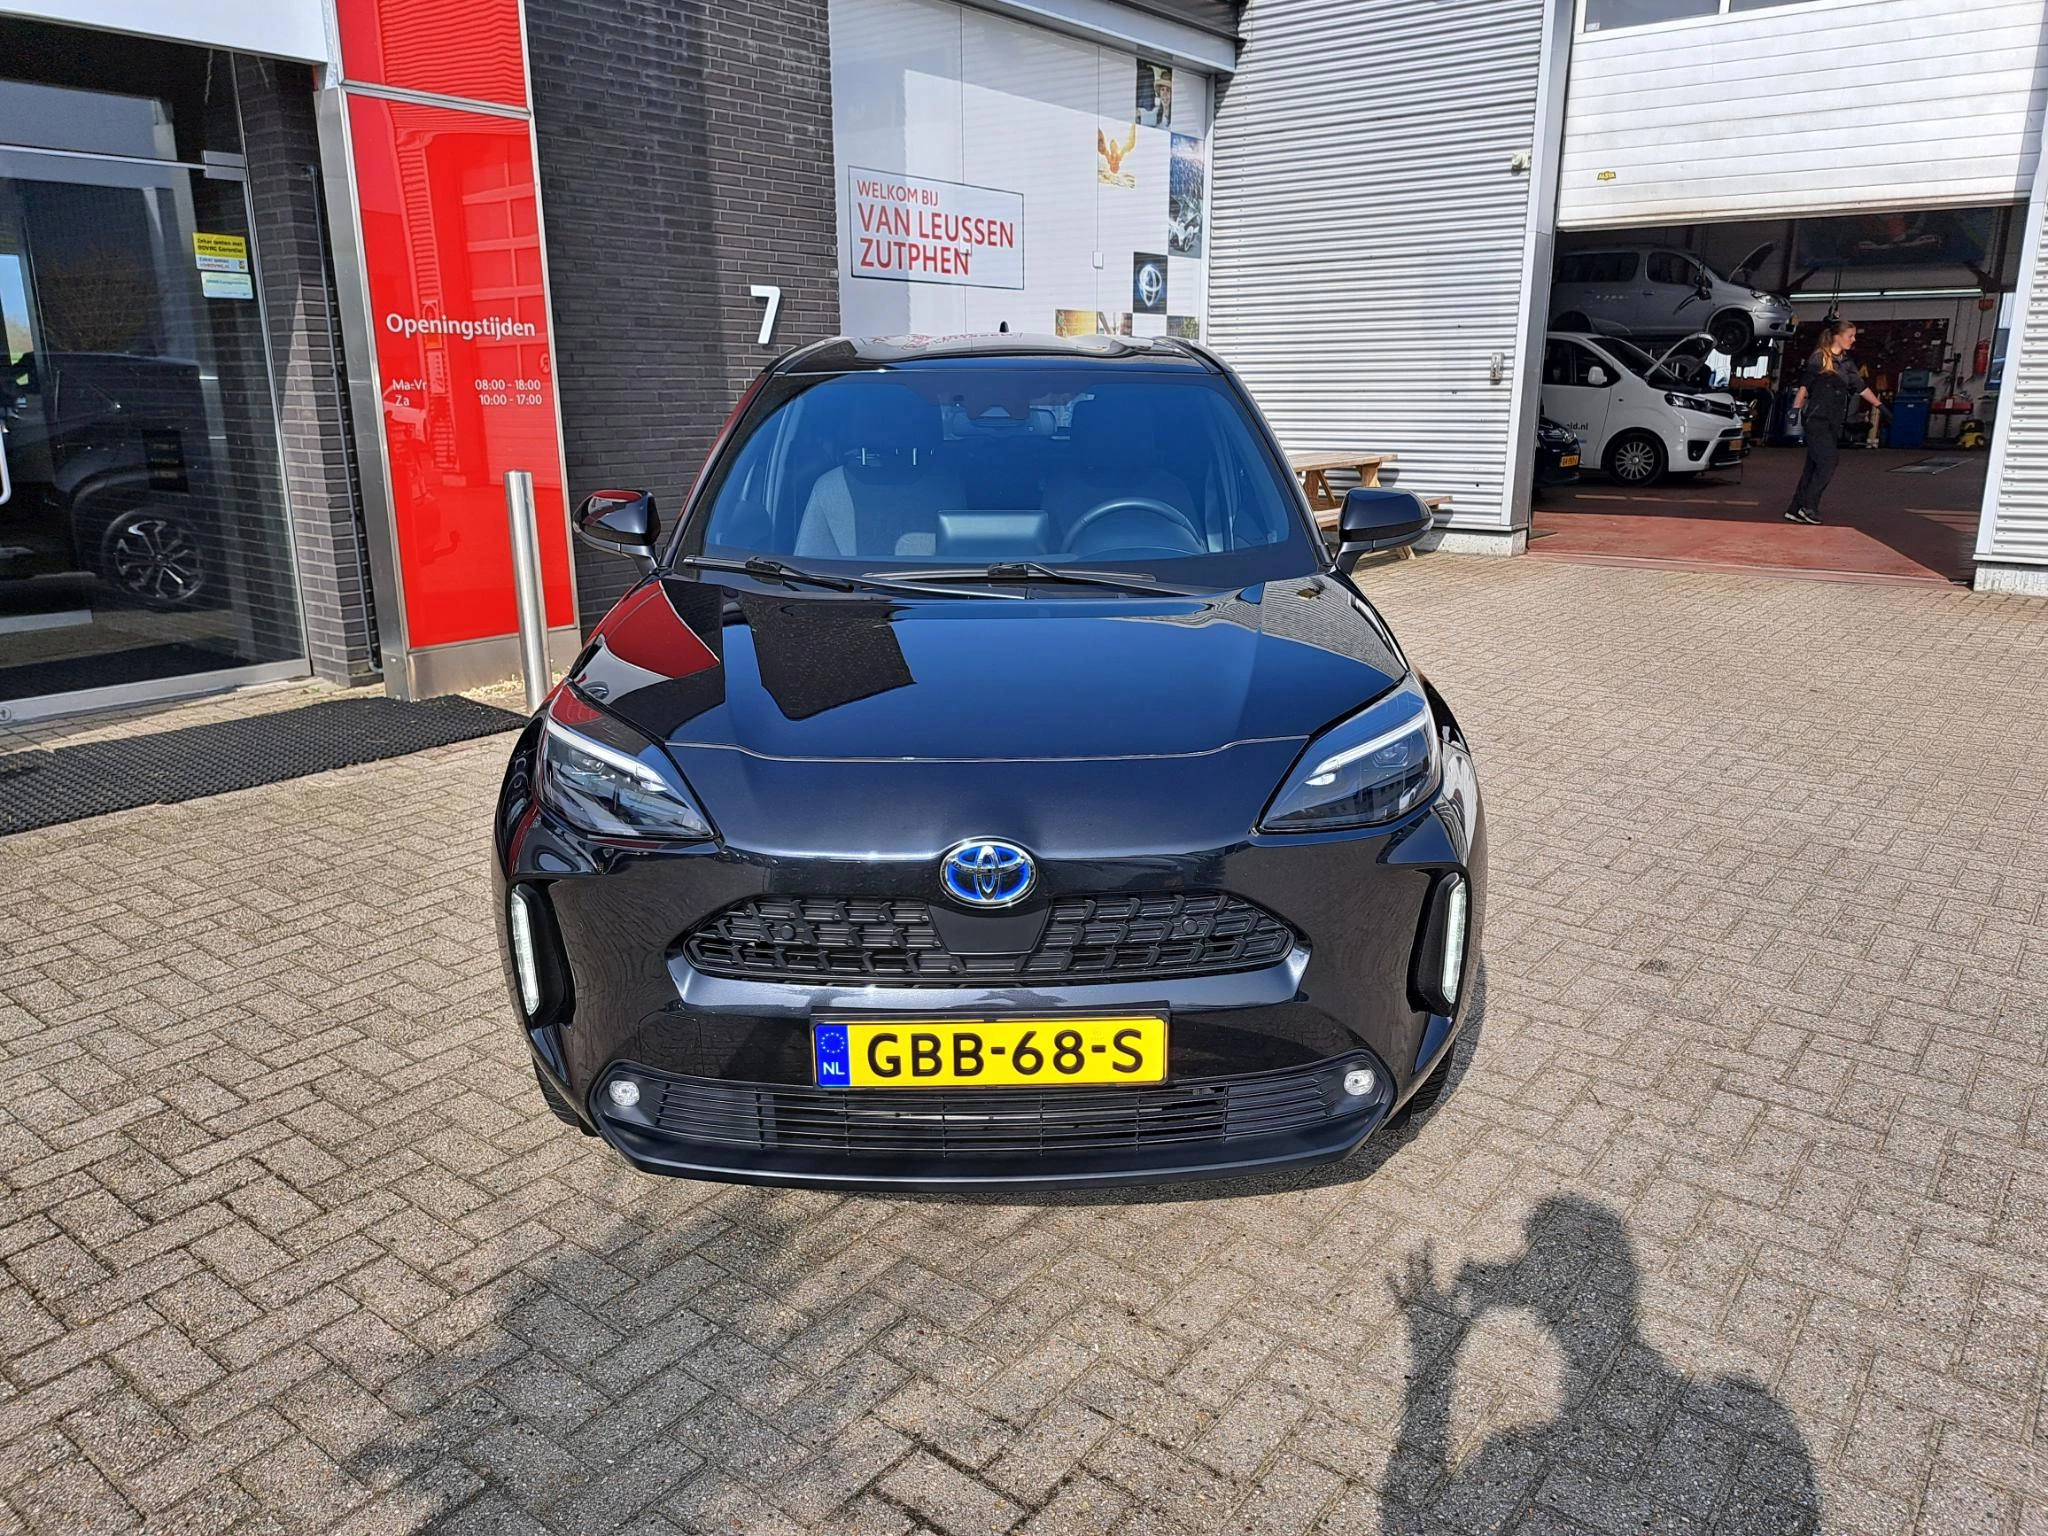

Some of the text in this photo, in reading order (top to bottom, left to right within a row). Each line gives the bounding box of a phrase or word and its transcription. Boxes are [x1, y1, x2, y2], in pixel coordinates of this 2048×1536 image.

[856, 179, 939, 207] WELKOM BIJ
[857, 202, 1014, 249] VAN LEUSSEN
[860, 237, 970, 276] ZUTPHEN
[386, 313, 536, 341] Openingstijden
[750, 285, 780, 344] 7
[392, 378, 427, 391] Ma-Vr
[474, 379, 505, 391] 08:00
[515, 379, 541, 391] 18:00
[395, 395, 410, 407] Za
[479, 394, 507, 405] 10:00
[517, 394, 543, 405] 17:00
[867, 1029, 1144, 1078] GBB-68-S
[823, 1062, 846, 1076] NL
